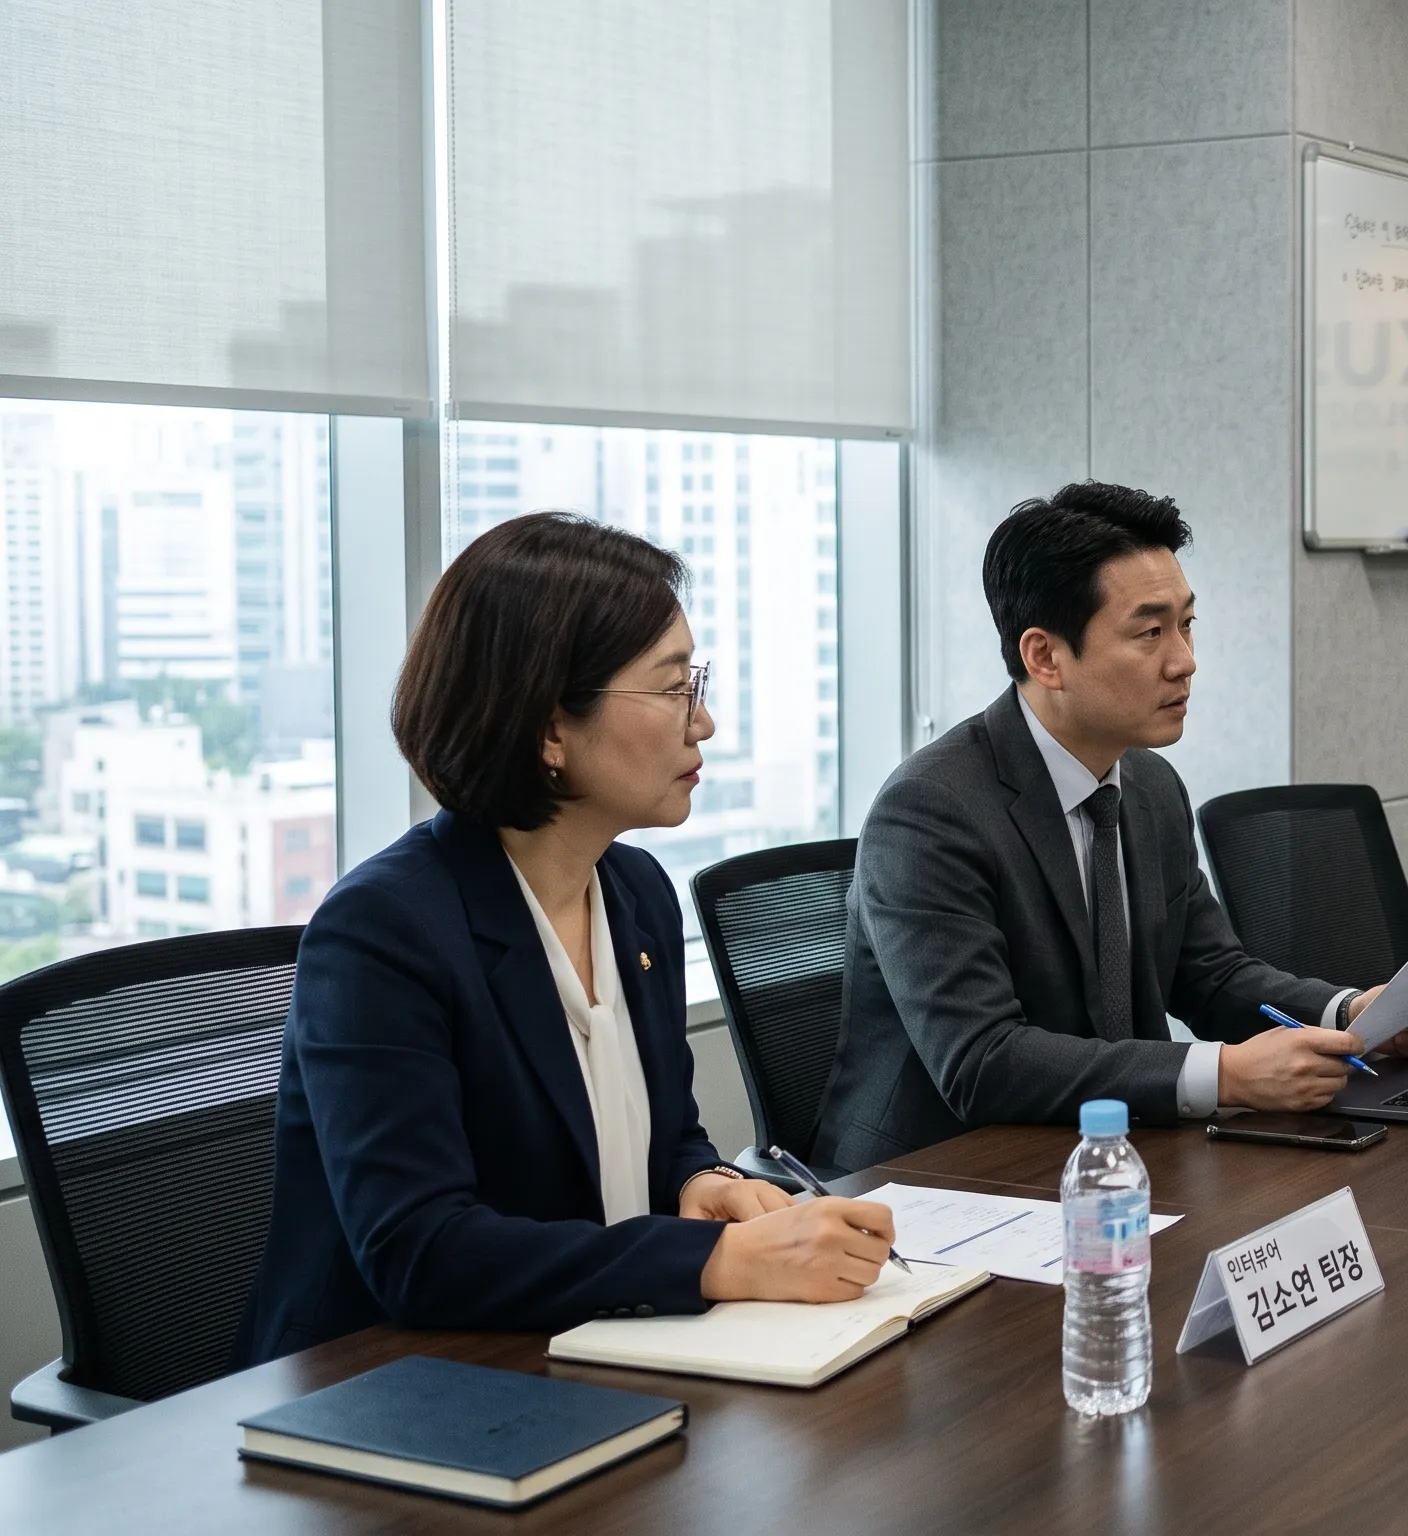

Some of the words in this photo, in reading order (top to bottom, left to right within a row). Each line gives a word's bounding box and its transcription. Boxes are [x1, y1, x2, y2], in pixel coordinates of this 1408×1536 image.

[1227, 1238, 1283, 1283] 인터뷰어
[1247, 1263, 1318, 1333] 김소연
[1318, 1240, 1364, 1293] 팀장
